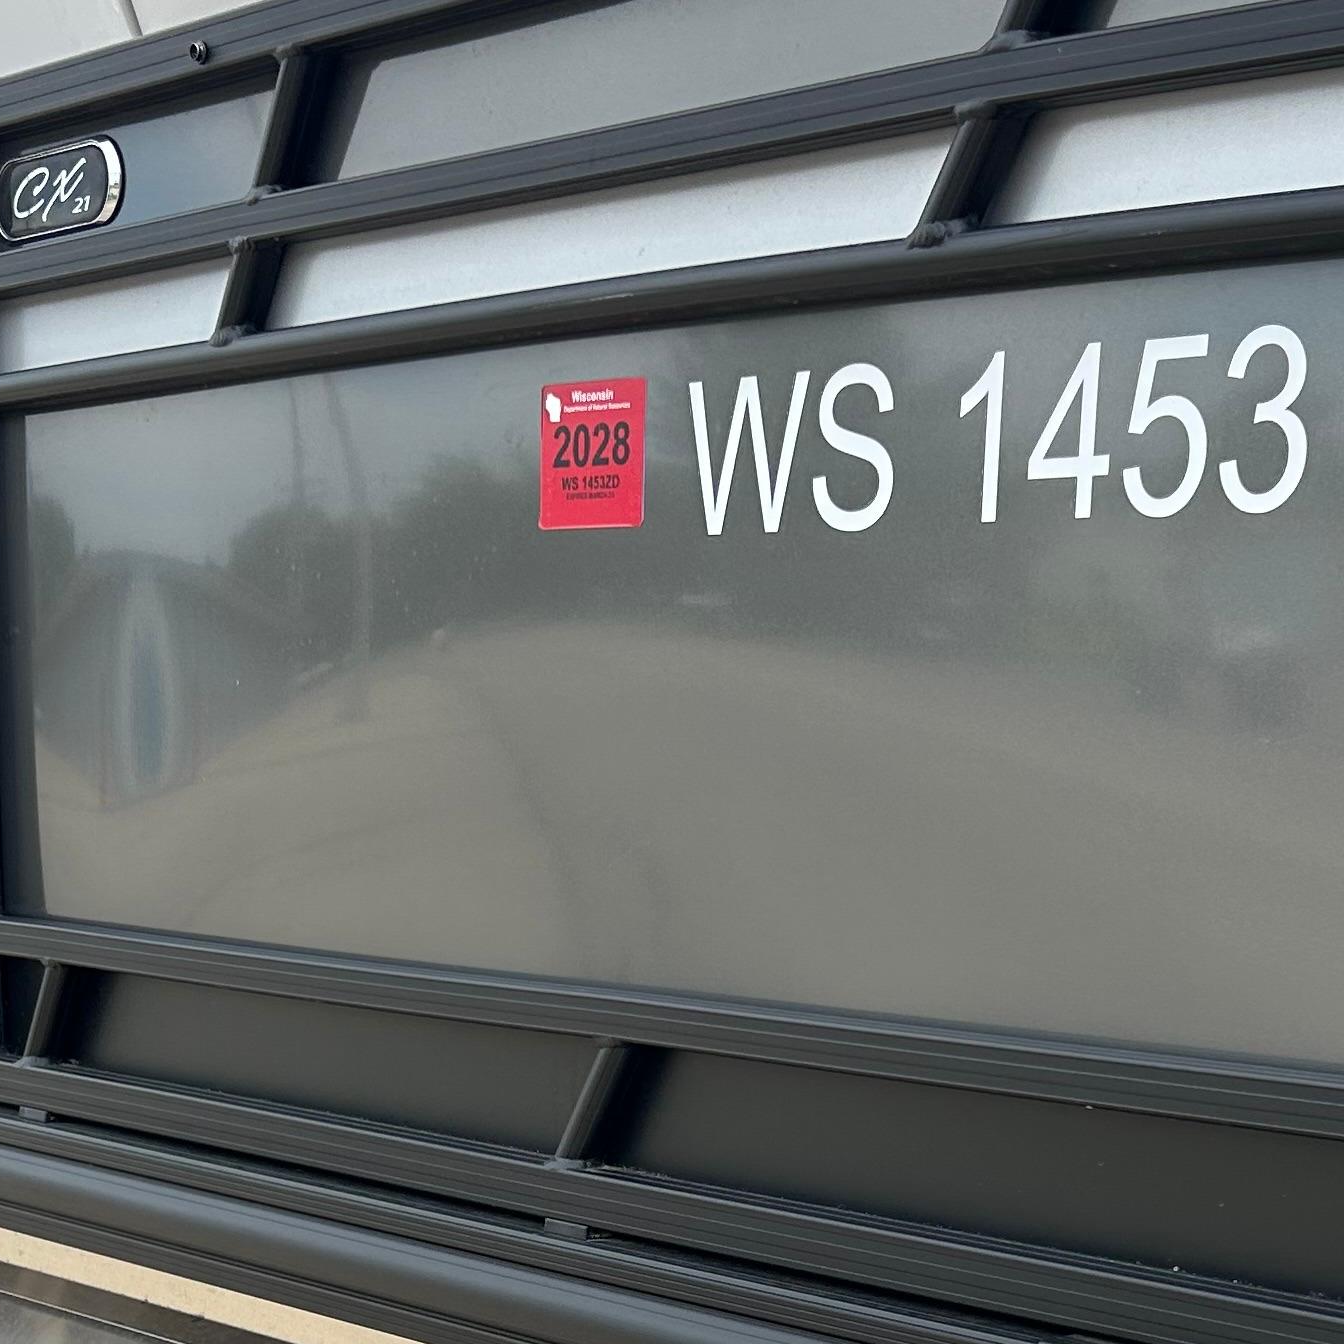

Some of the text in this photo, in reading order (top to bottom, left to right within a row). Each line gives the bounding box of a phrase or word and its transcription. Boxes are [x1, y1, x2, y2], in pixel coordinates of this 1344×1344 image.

[13, 157, 91, 223] CX 21
[571, 388, 614, 403] Wisconsin
[552, 420, 631, 468] 2028
[688, 361, 895, 537] WS
[958, 323, 1309, 524] 1453
[561, 474, 621, 491] WS 1453ZD
